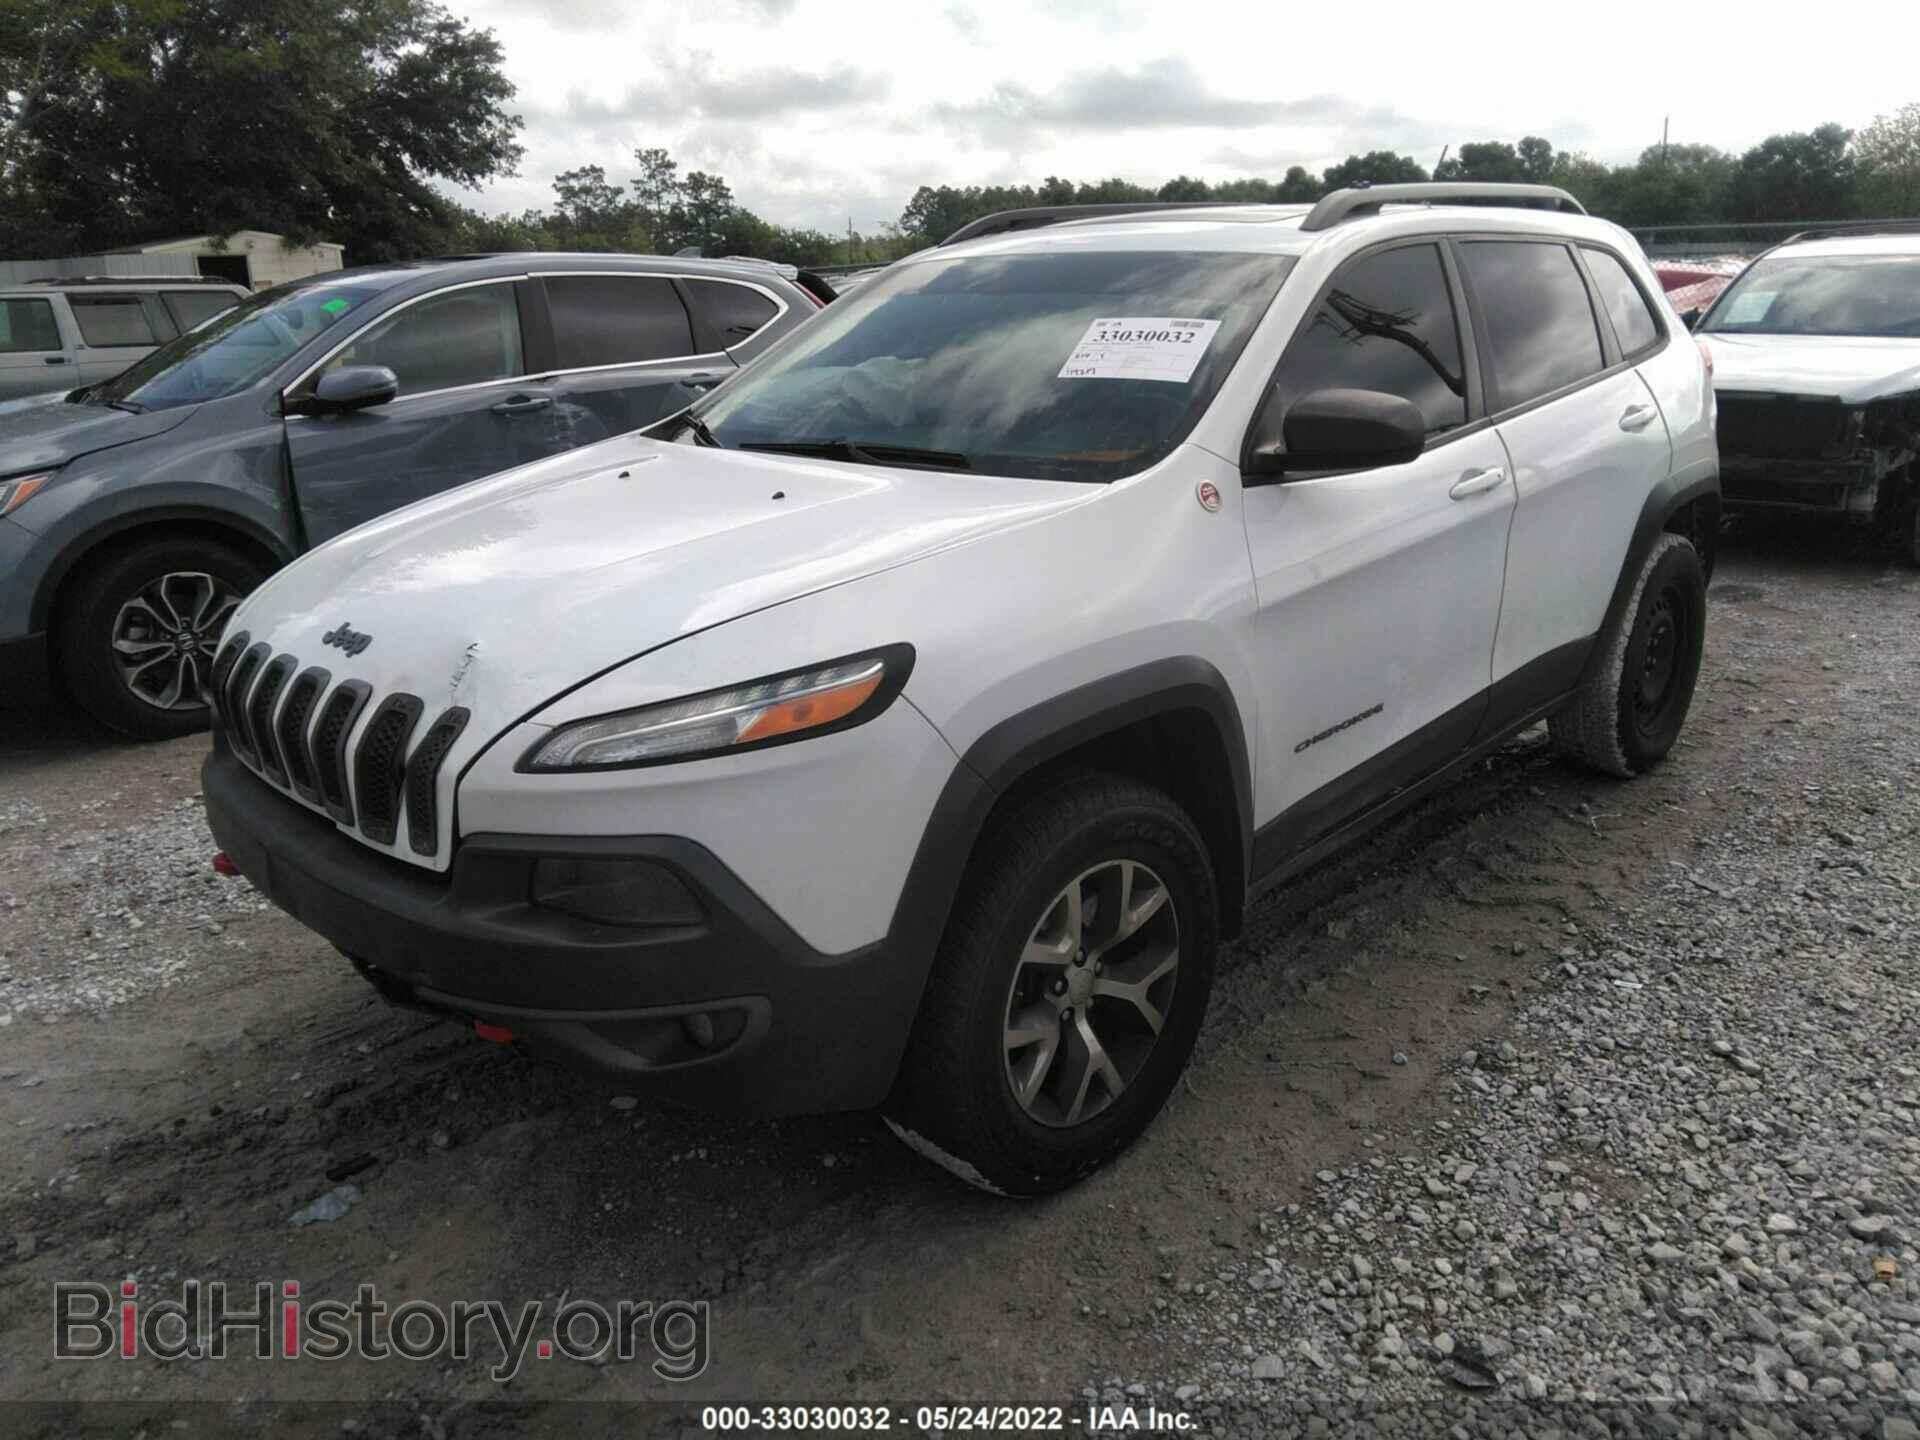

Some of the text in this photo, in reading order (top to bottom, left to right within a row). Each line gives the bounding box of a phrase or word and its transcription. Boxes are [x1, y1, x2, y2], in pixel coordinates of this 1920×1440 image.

[1092, 330, 1196, 344] 33030032
[322, 622, 373, 658] Jeep
[1294, 703, 1384, 753] CHEROKEE
